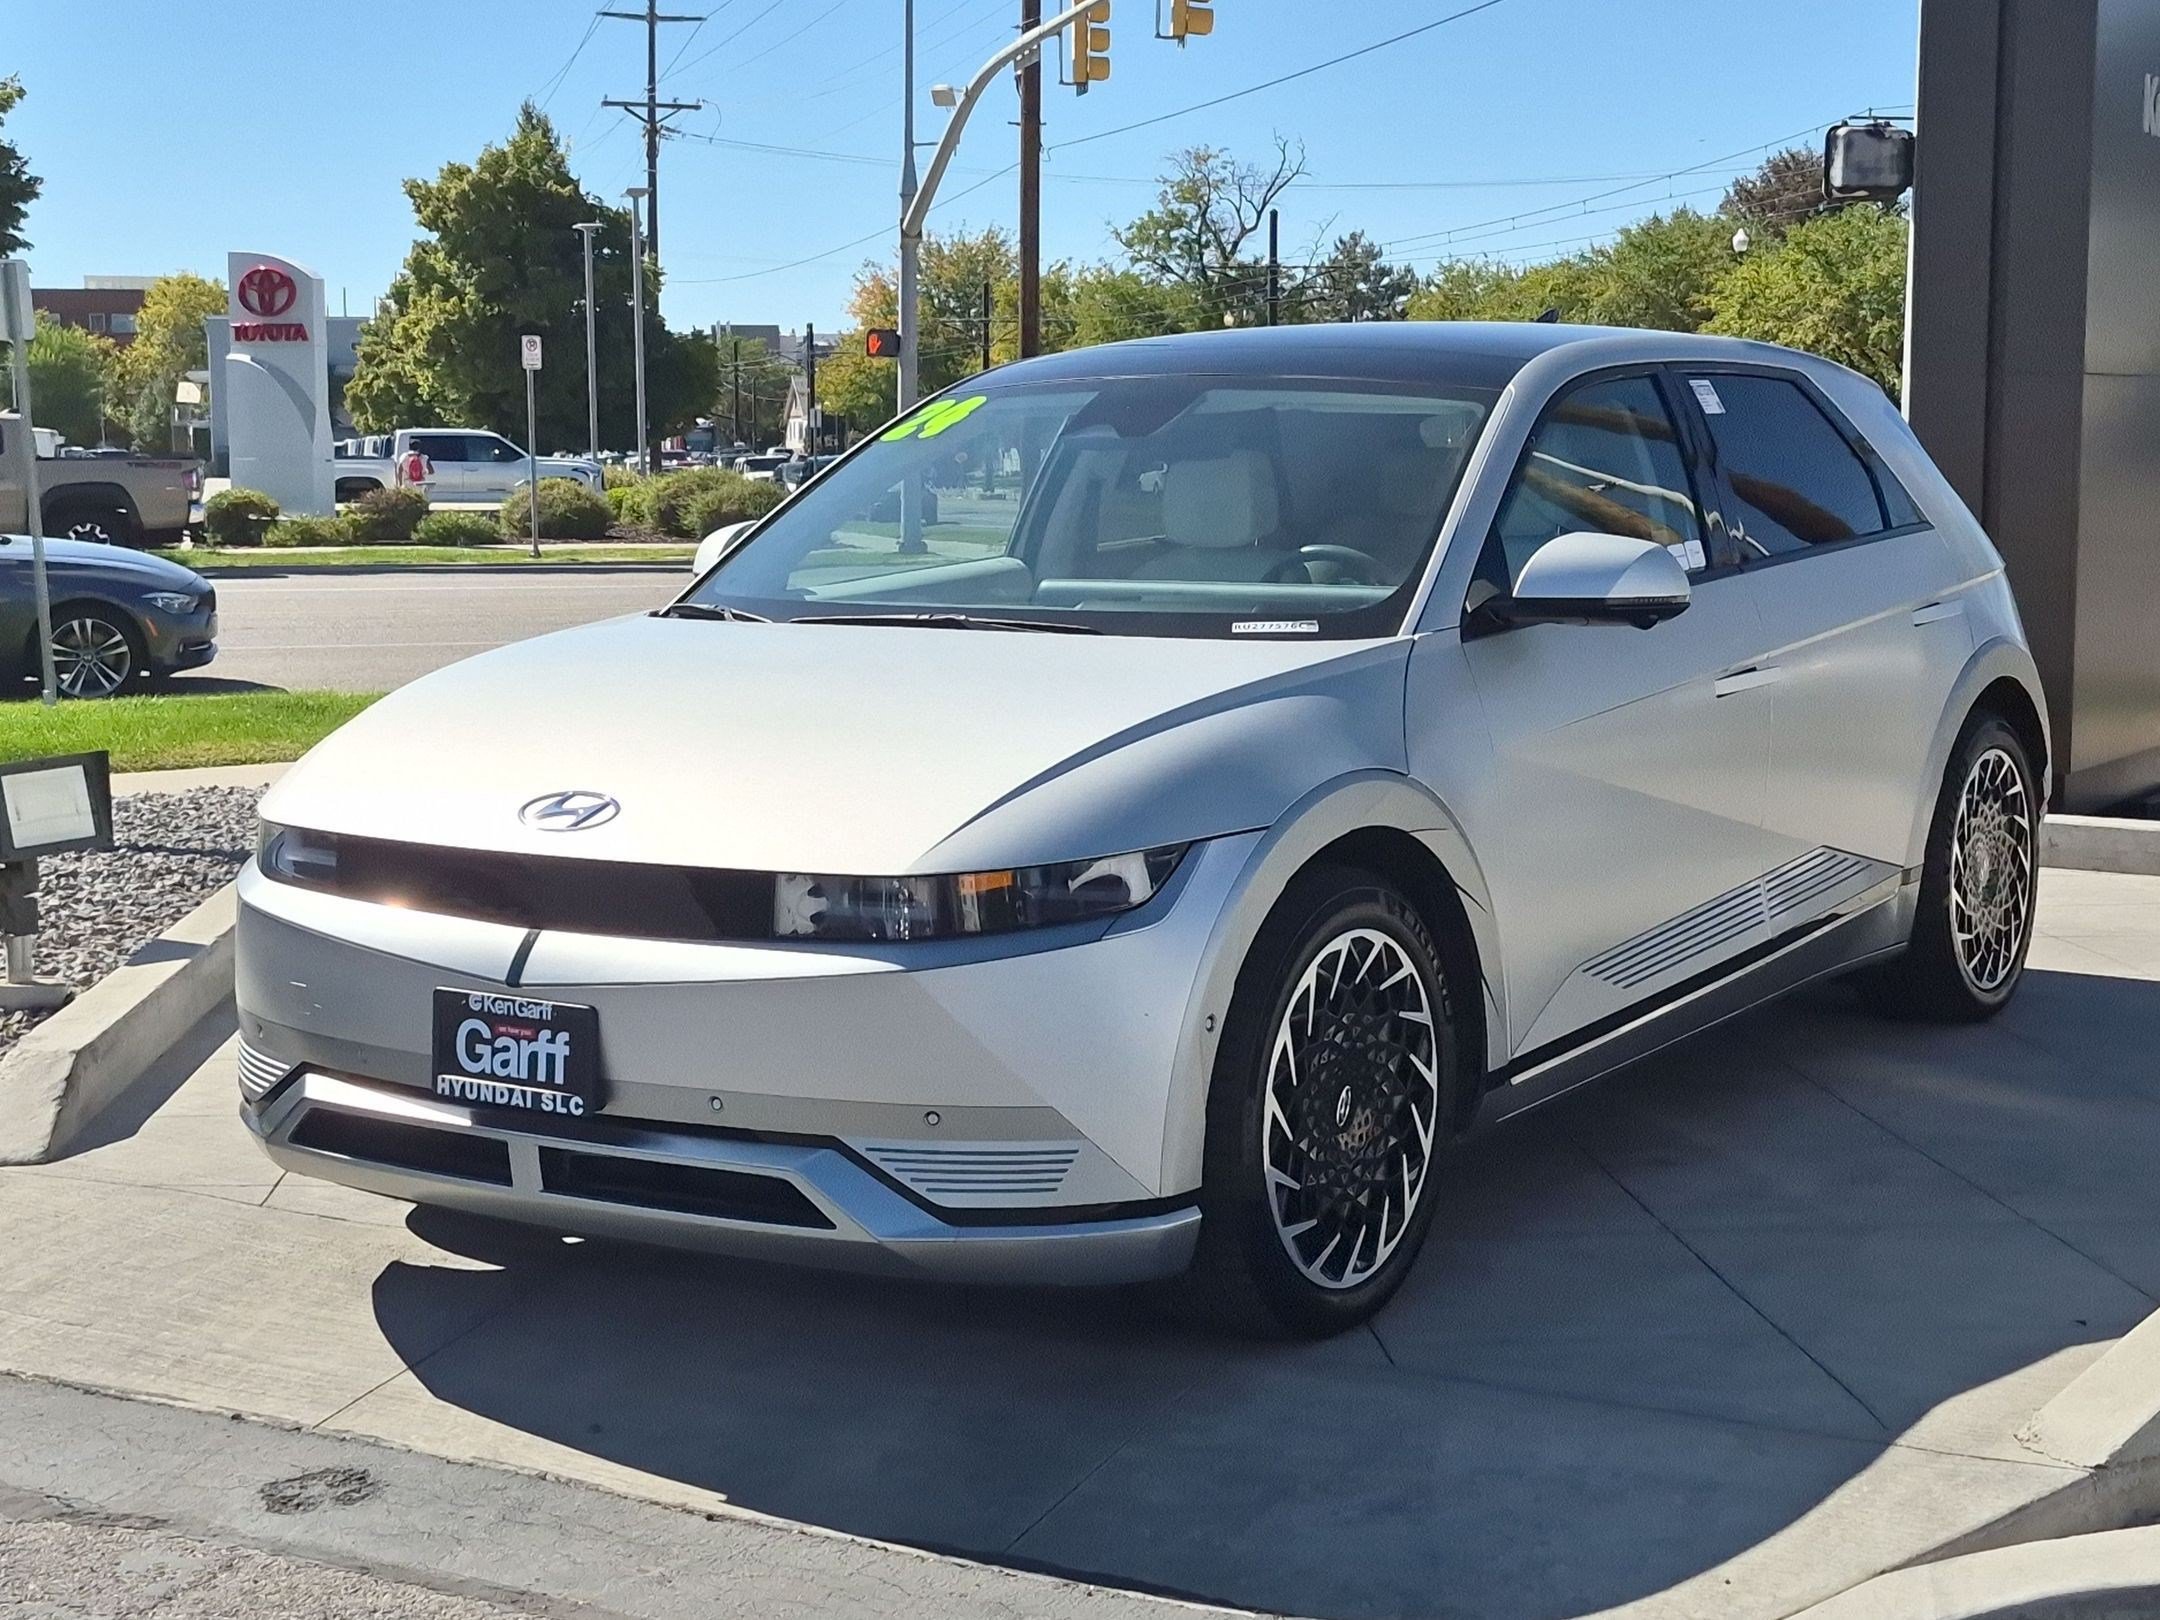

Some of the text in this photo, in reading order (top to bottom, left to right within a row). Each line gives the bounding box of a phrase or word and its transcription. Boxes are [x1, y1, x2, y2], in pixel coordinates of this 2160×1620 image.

[230, 323, 309, 342] TOYOTA
[456, 1018, 570, 1085] Garff
[437, 1075, 584, 1116] HYUNDAI SLC
